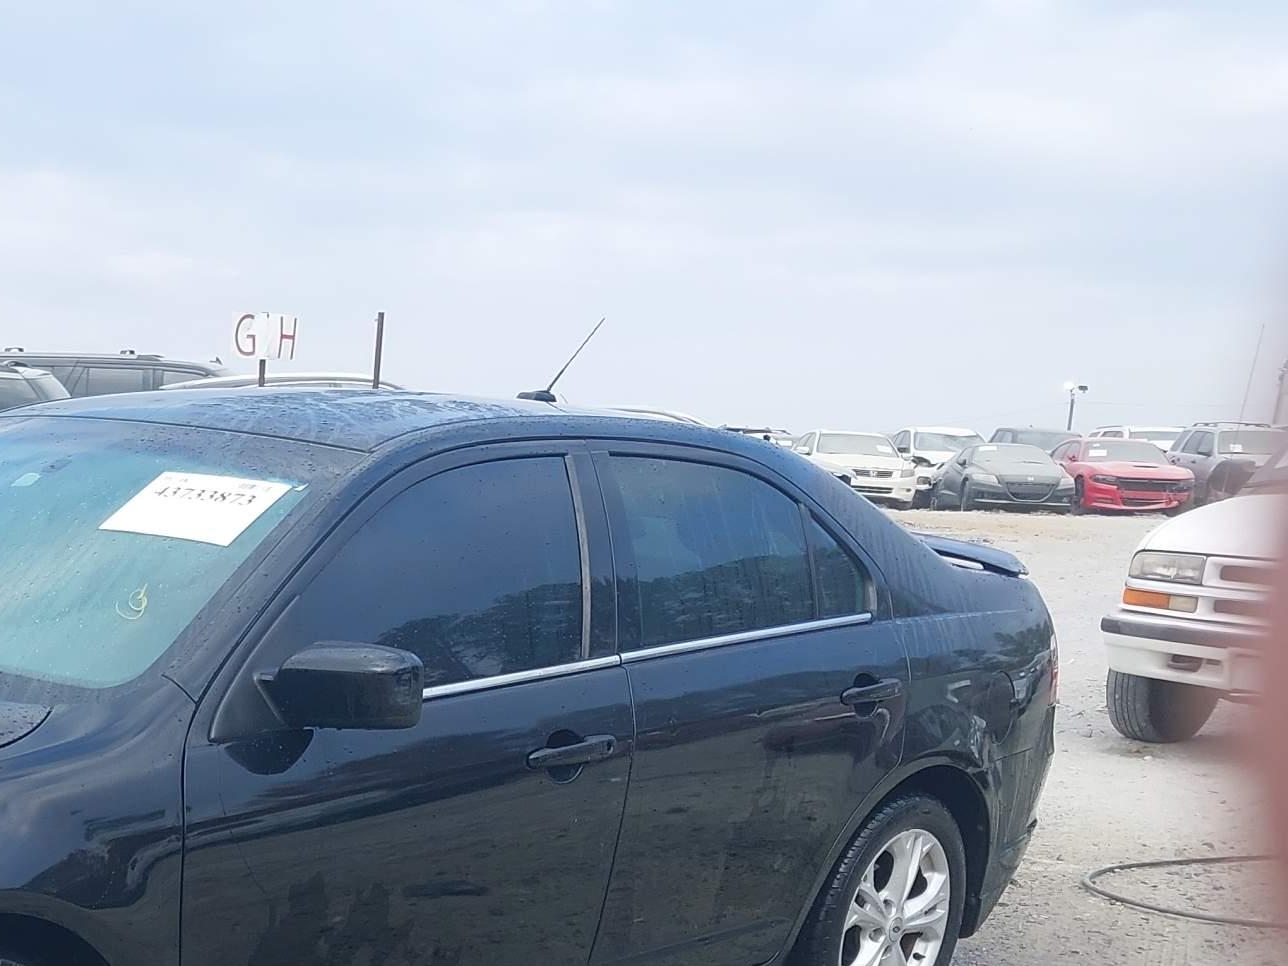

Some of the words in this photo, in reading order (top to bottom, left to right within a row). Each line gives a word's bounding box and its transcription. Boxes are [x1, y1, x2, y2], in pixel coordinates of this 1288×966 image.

[235, 314, 256, 356] G
[277, 316, 297, 360] H
[154, 486, 257, 506] 43733873
